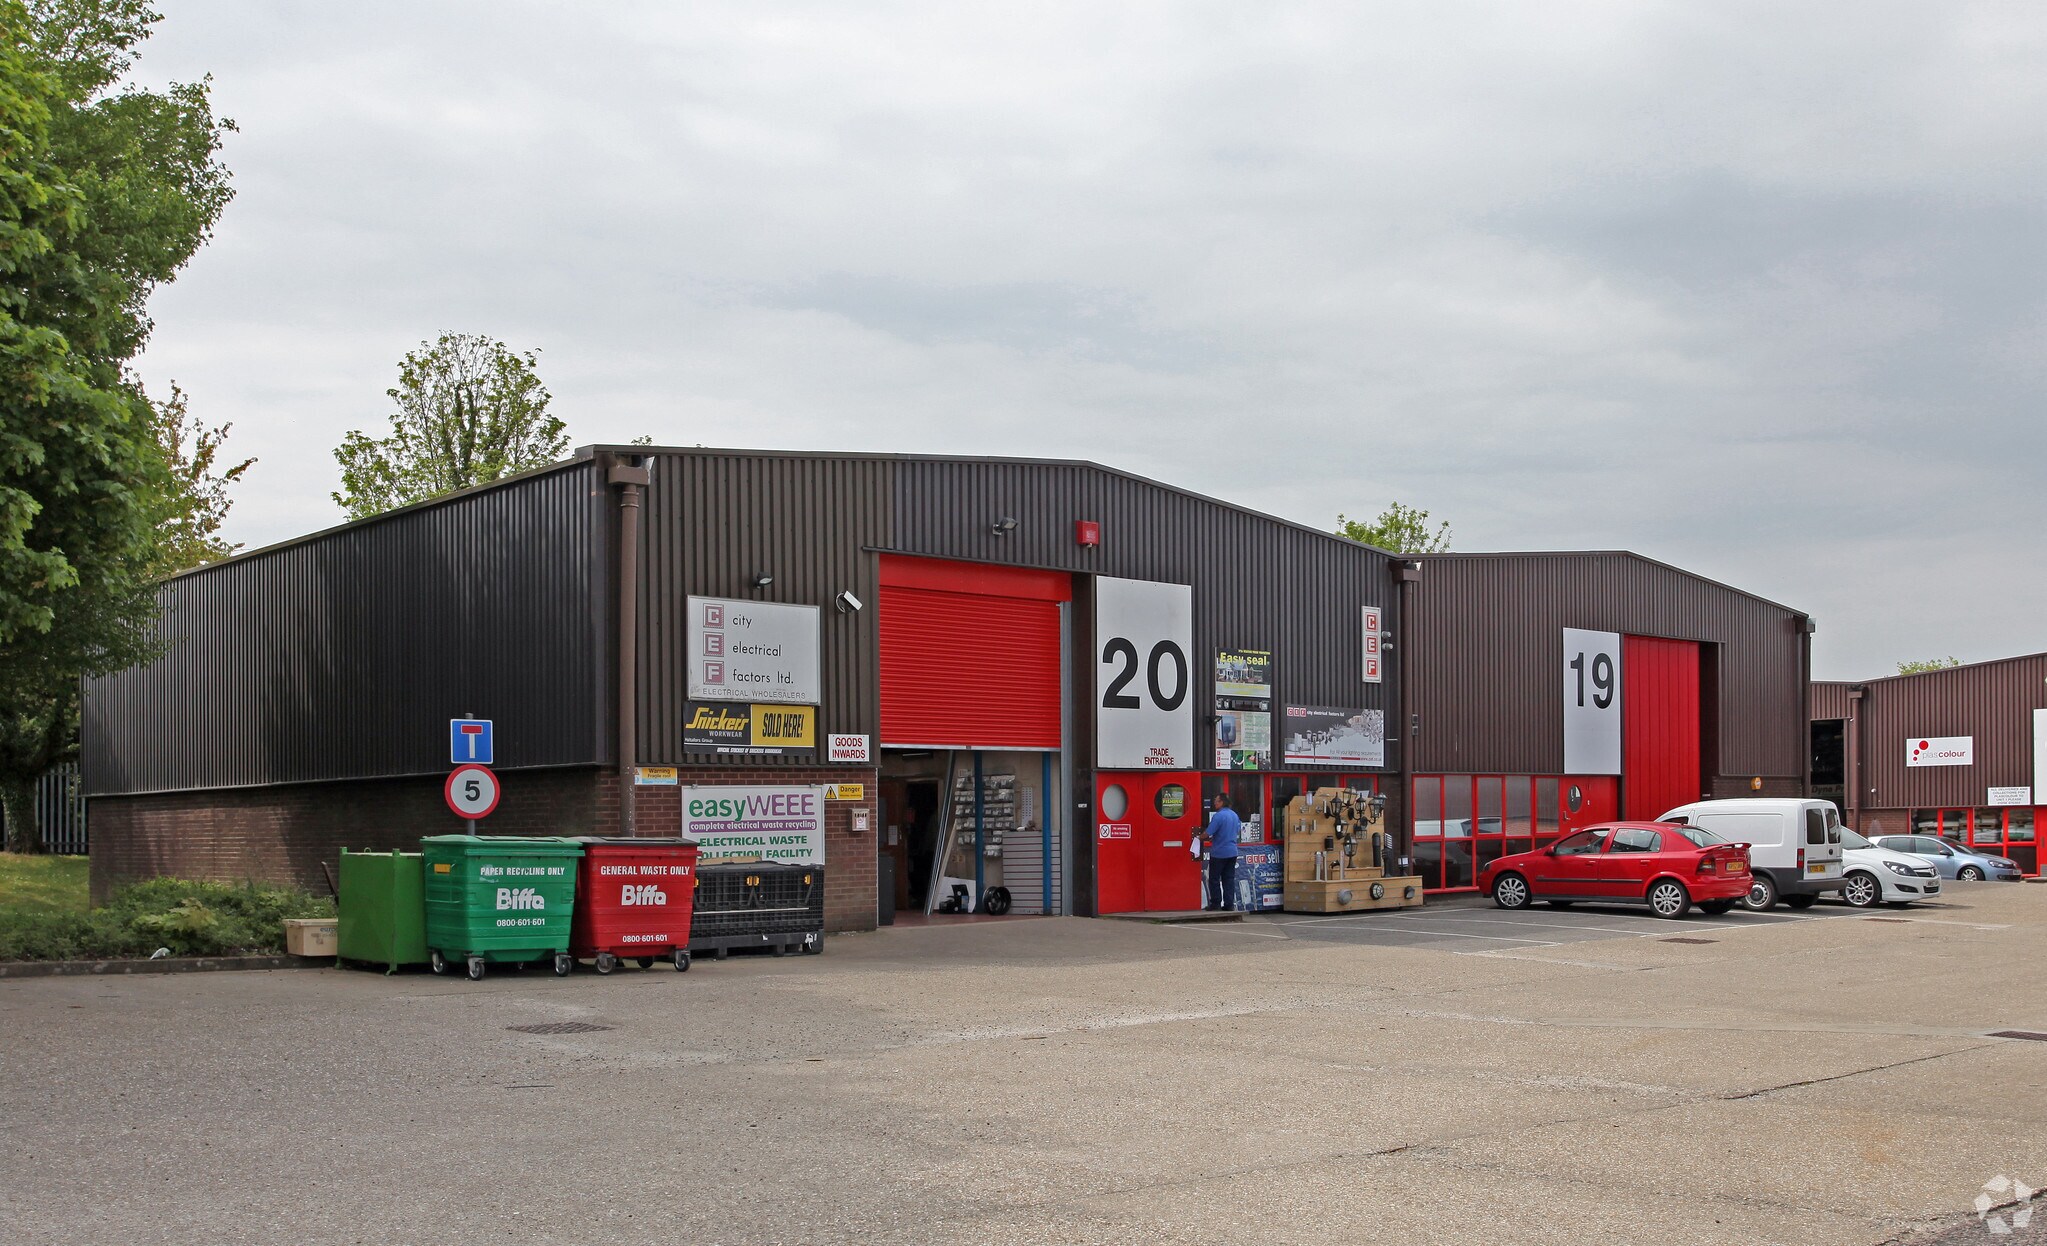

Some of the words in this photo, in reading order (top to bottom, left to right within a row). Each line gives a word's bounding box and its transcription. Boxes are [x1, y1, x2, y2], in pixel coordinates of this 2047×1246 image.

[732, 614, 753, 628] city
[732, 641, 781, 657] electrical
[1220, 652, 1244, 665] Easy
[732, 668, 771, 683] factors
[777, 671, 794, 684] ltd.
[1102, 636, 1188, 712] 20
[1570, 652, 1614, 709] 19
[703, 688, 749, 697] ELECTRICAL
[751, 690, 806, 700] WHOLESALERS
[685, 707, 750, 730] Snickers
[762, 713, 782, 738] SOLD
[782, 714, 805, 738] HERE!
[708, 730, 743, 738] WORKWEAR
[835, 737, 863, 747] GOODS
[832, 749, 866, 759] INWARDS
[1149, 748, 1169, 757] TRADE
[1921, 750, 1965, 762] plascolour
[1143, 756, 1174, 766] ENTRANCE
[465, 780, 481, 802] 5
[688, 794, 815, 821] easyWEEE
[690, 821, 725, 831] complete
[726, 820, 761, 830] electrical
[762, 820, 784, 829] waste
[784, 819, 816, 830] recycling
[699, 836, 766, 847] ELECTRICAL
[769, 834, 808, 845] WASTE
[700, 850, 763, 860] OLLECTION
[766, 848, 813, 859] FACILITY
[1267, 850, 1280, 864] sell
[480, 867, 504, 877] PAPER
[506, 866, 545, 876] RECYCLING
[547, 866, 566, 876] ONLY
[600, 865, 638, 876] GENERAL
[640, 865, 668, 875] WASTE
[669, 865, 690, 876] ONLY
[496, 887, 545, 910] Biffa
[621, 885, 667, 906] Biffa
